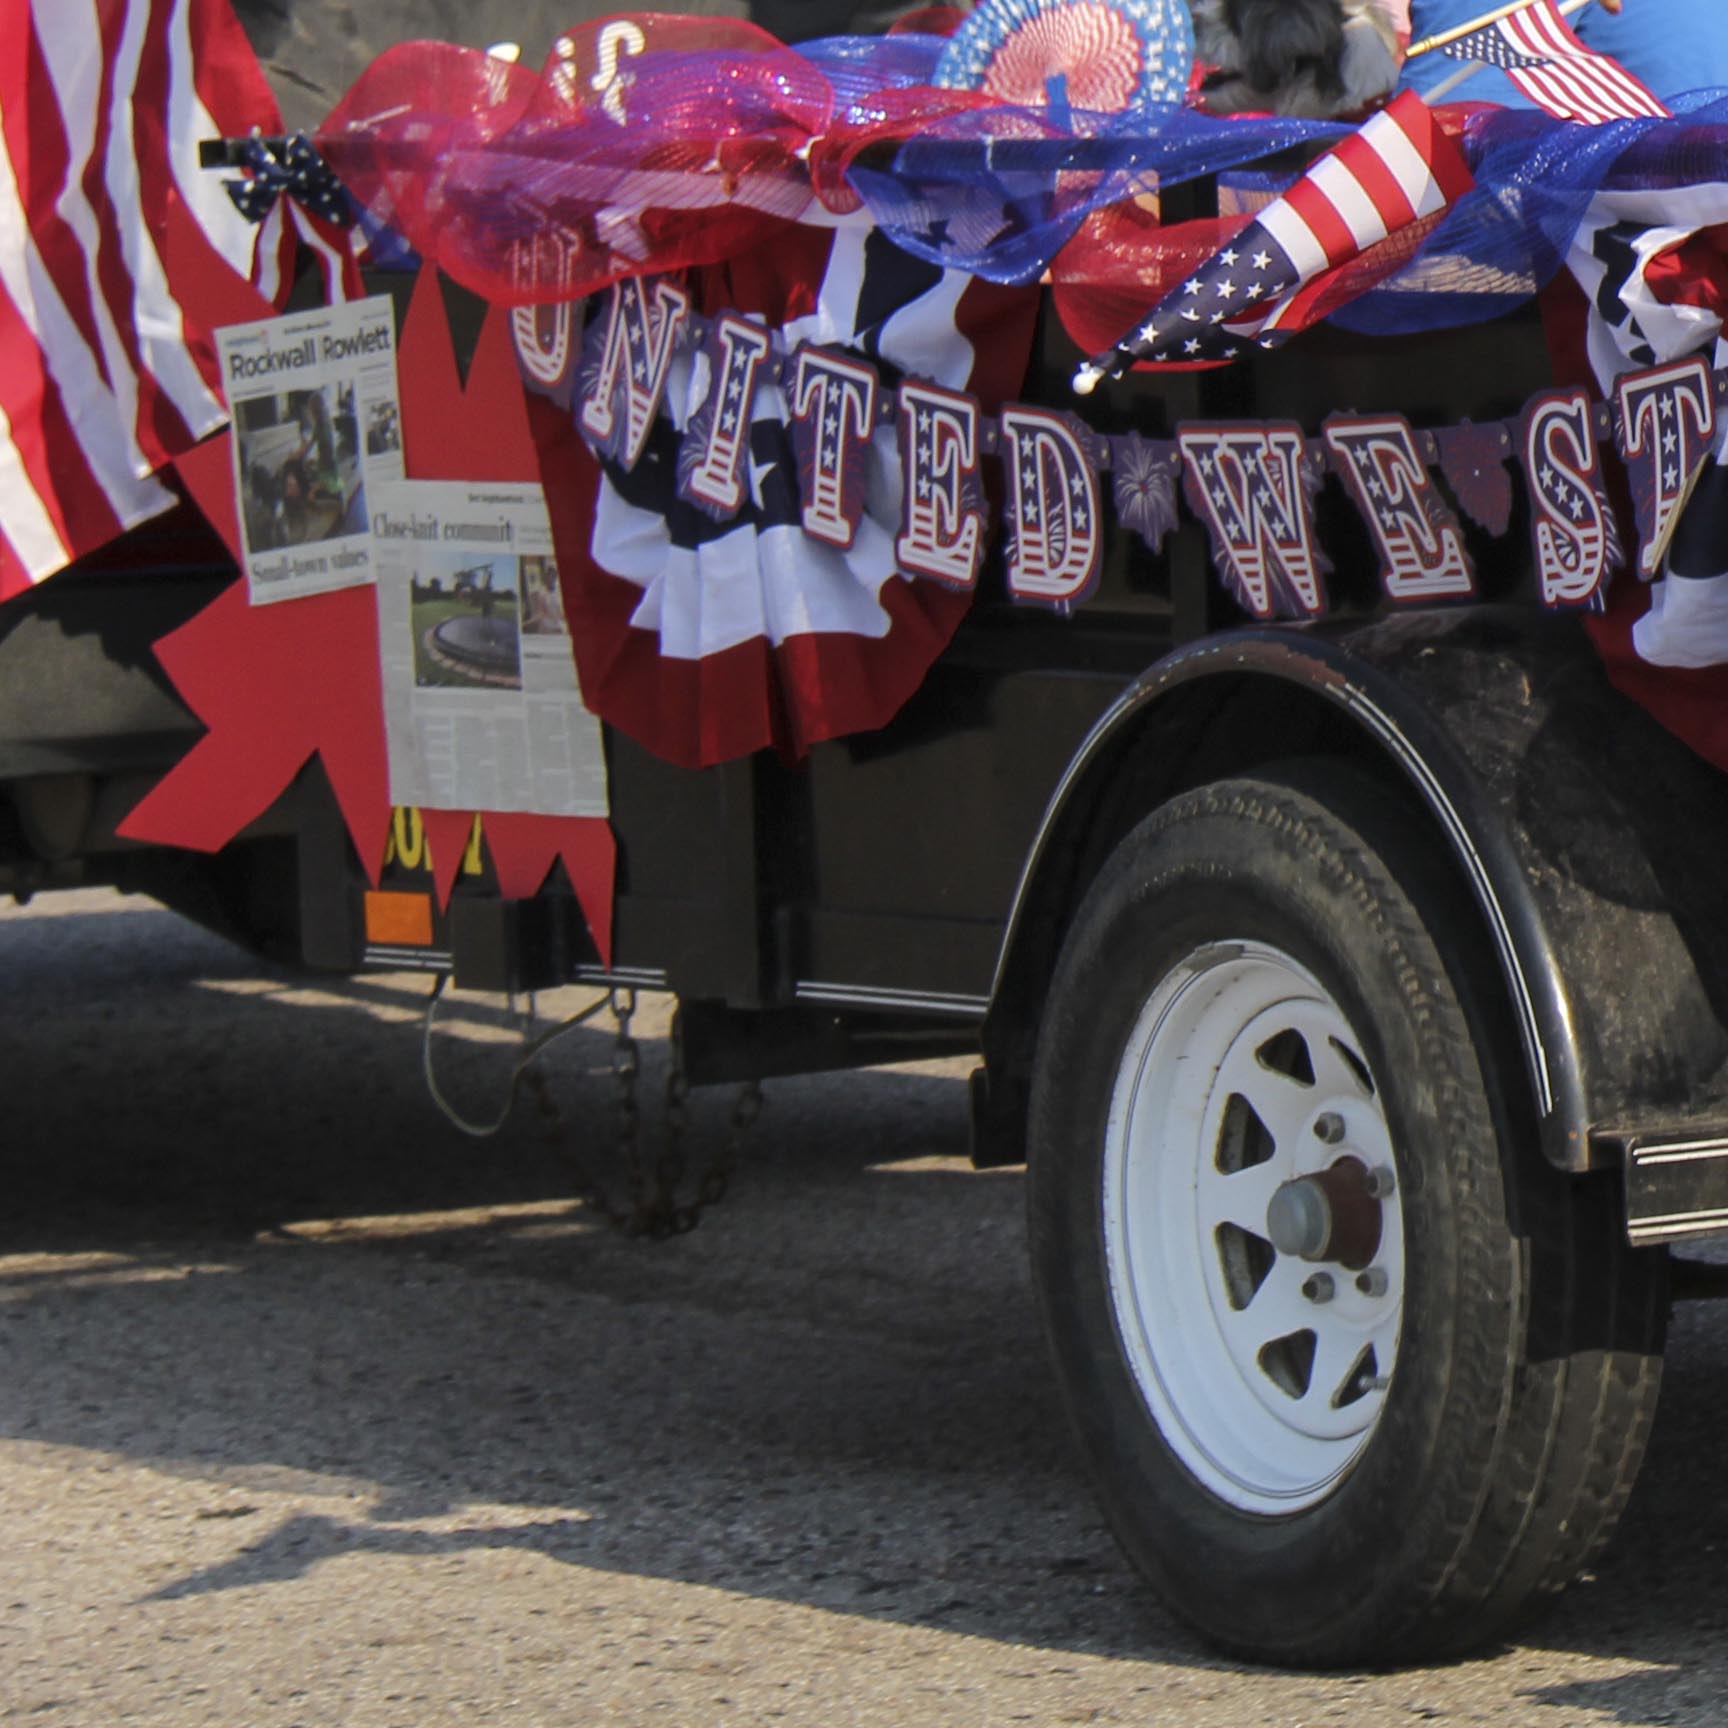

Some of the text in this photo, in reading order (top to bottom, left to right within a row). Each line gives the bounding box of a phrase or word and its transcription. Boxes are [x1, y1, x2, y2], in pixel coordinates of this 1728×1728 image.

[228, 337, 317, 381] Rockwall
[322, 324, 392, 363] Rowlett
[510, 225, 1101, 600] UNITED
[1178, 414, 1474, 618] WE
